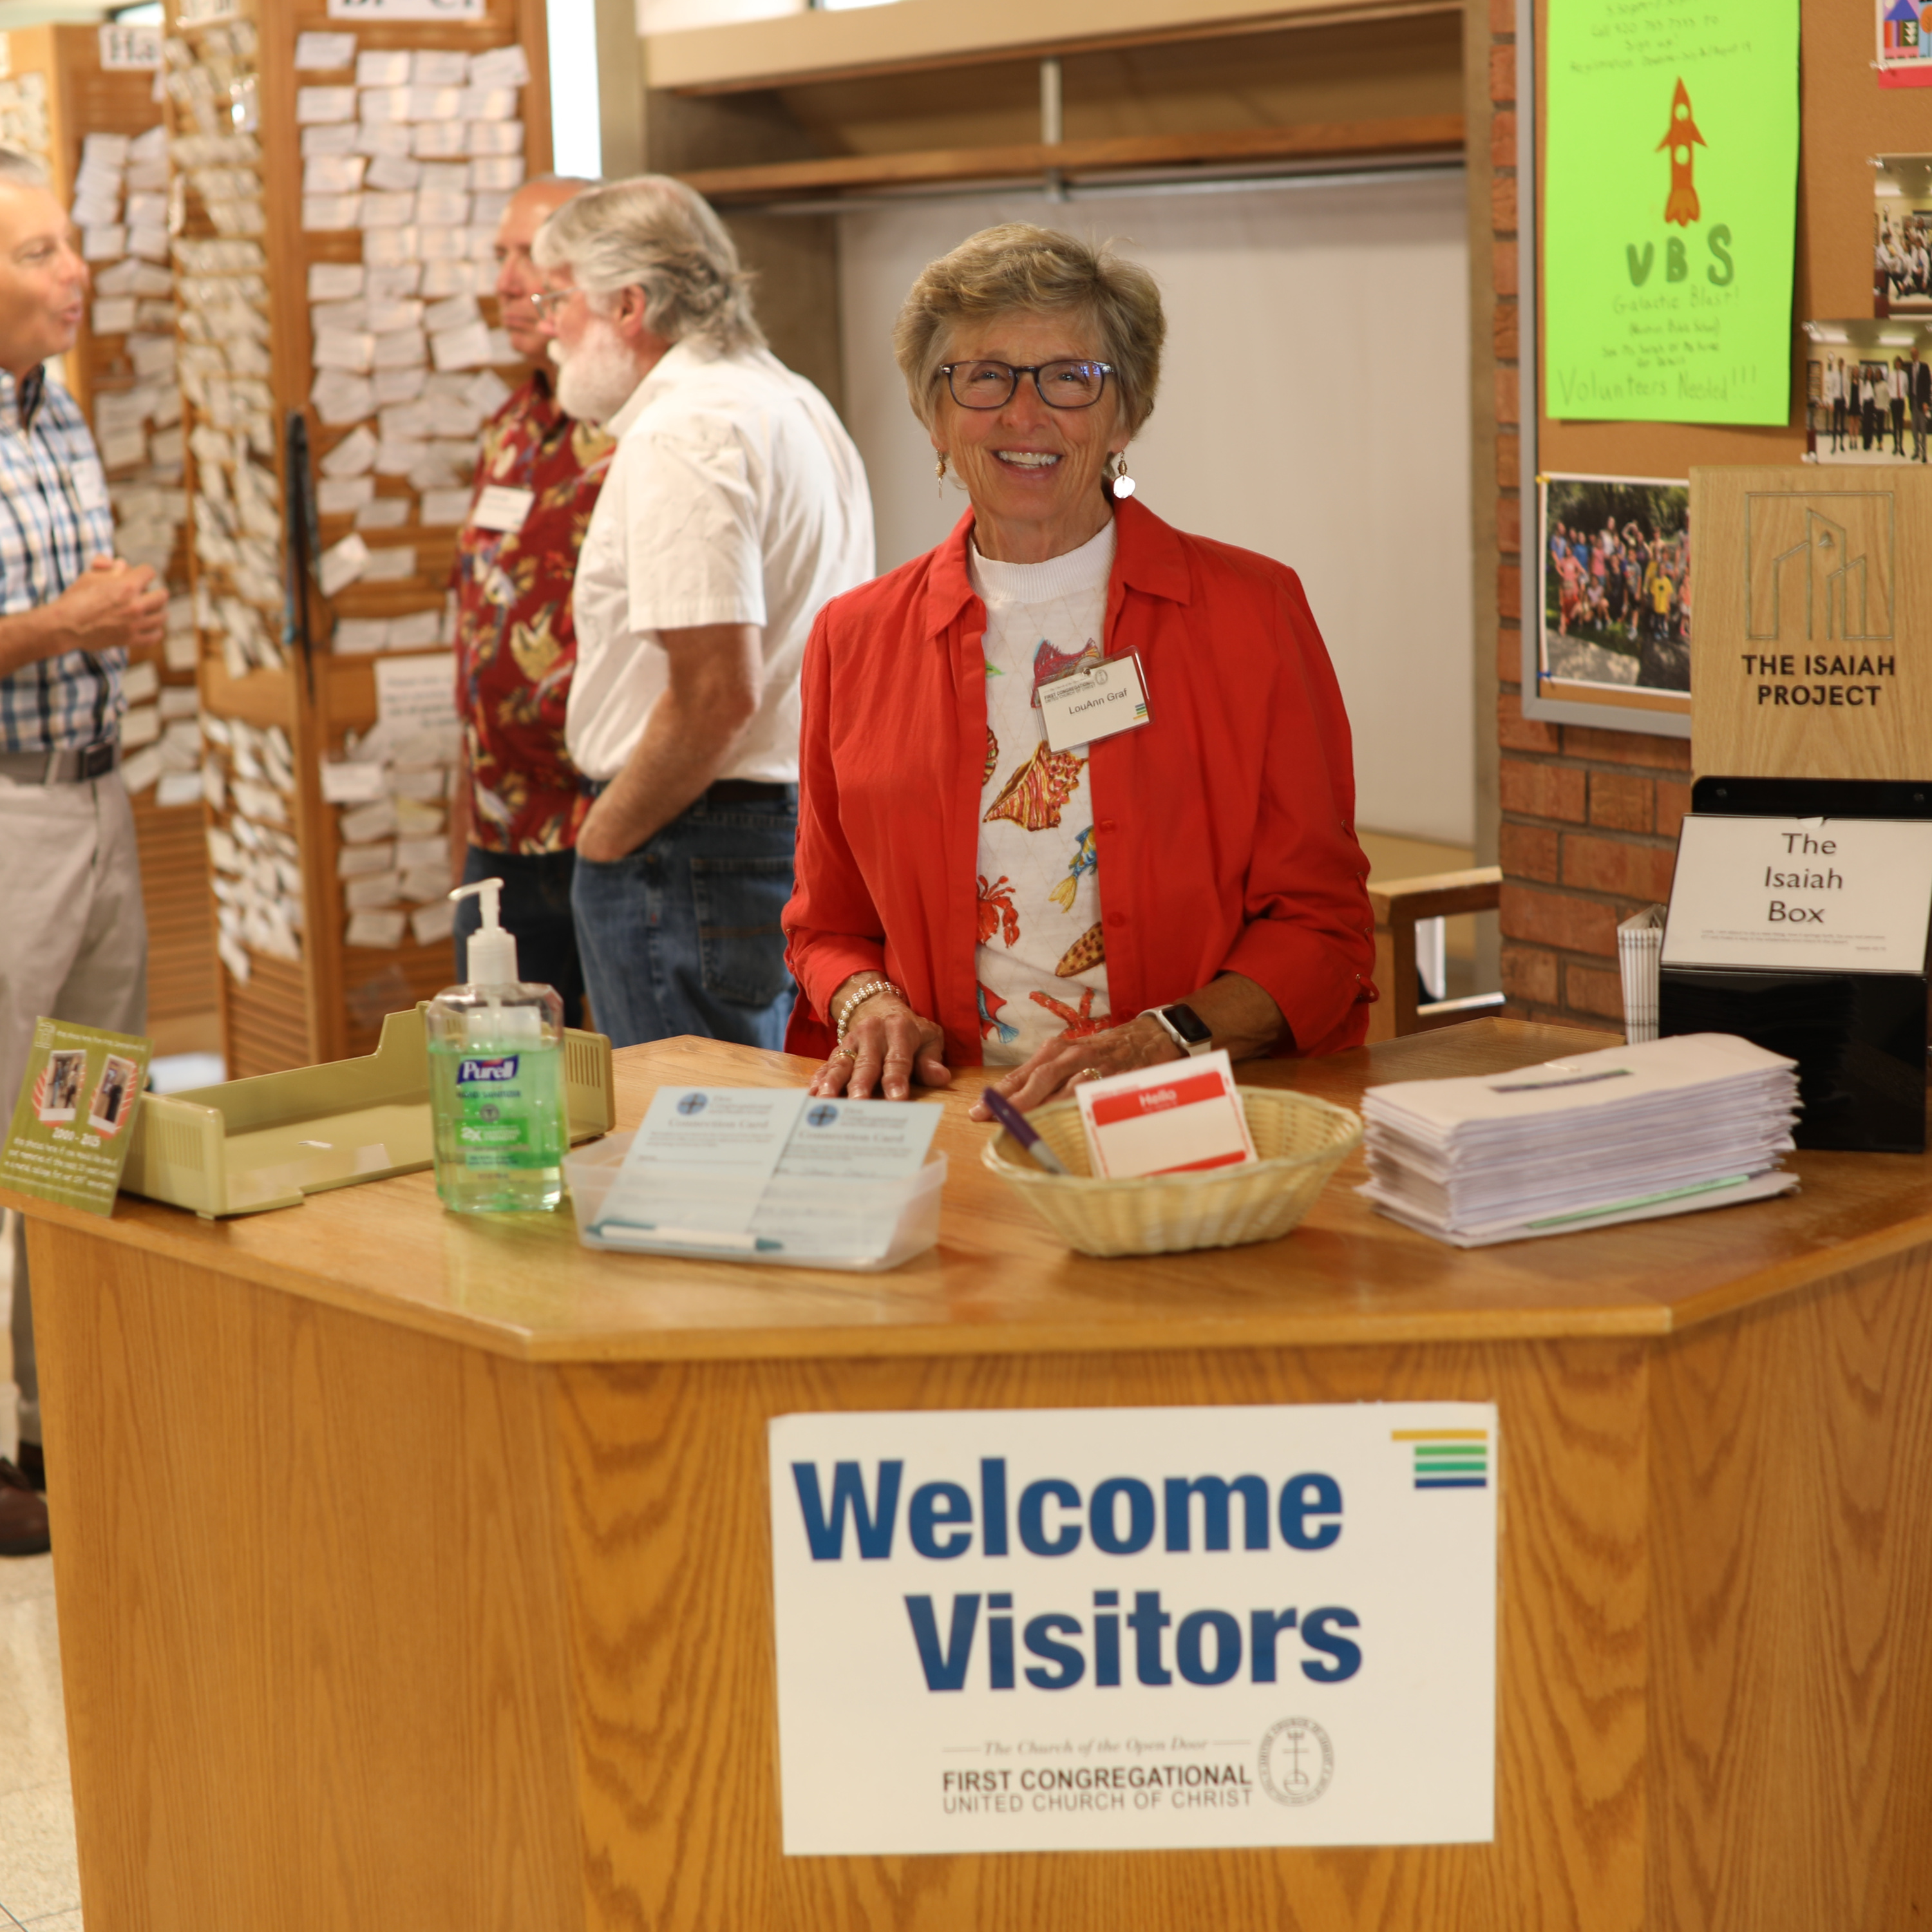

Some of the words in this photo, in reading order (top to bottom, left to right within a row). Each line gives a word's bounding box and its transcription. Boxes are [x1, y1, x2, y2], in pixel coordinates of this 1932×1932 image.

[1557, 365, 1668, 407] Volunteers
[1741, 654, 1795, 676] THE
[1804, 654, 1896, 677] ISAIAH
[1068, 697, 1105, 715] LouAnn
[1107, 688, 1128, 702] Graf
[1757, 684, 1882, 706] PROJECT
[1781, 833, 1837, 855] The
[1765, 866, 1843, 889] Isaiah
[1768, 900, 1825, 923] Box
[462, 1061, 515, 1080] Purell
[1138, 1088, 1178, 1107] Hello
[790, 1457, 1343, 1562] Welcome
[903, 1589, 1363, 1693] Visitors
[984, 1741, 1013, 1756] The
[1016, 1739, 1074, 1756] Church
[1077, 1739, 1095, 1757] of
[1096, 1739, 1121, 1754] the
[1125, 1738, 1166, 1756] Open
[1170, 1736, 1210, 1752] Door
[942, 1770, 1012, 1793] FIRST
[1020, 1765, 1253, 1792] CONGREGATIONAL
[943, 1792, 1024, 1815] UNITED
[1032, 1790, 1125, 1812] CHURCH
[1133, 1790, 1162, 1810] OF
[1171, 1788, 1253, 1809] CHRIST
